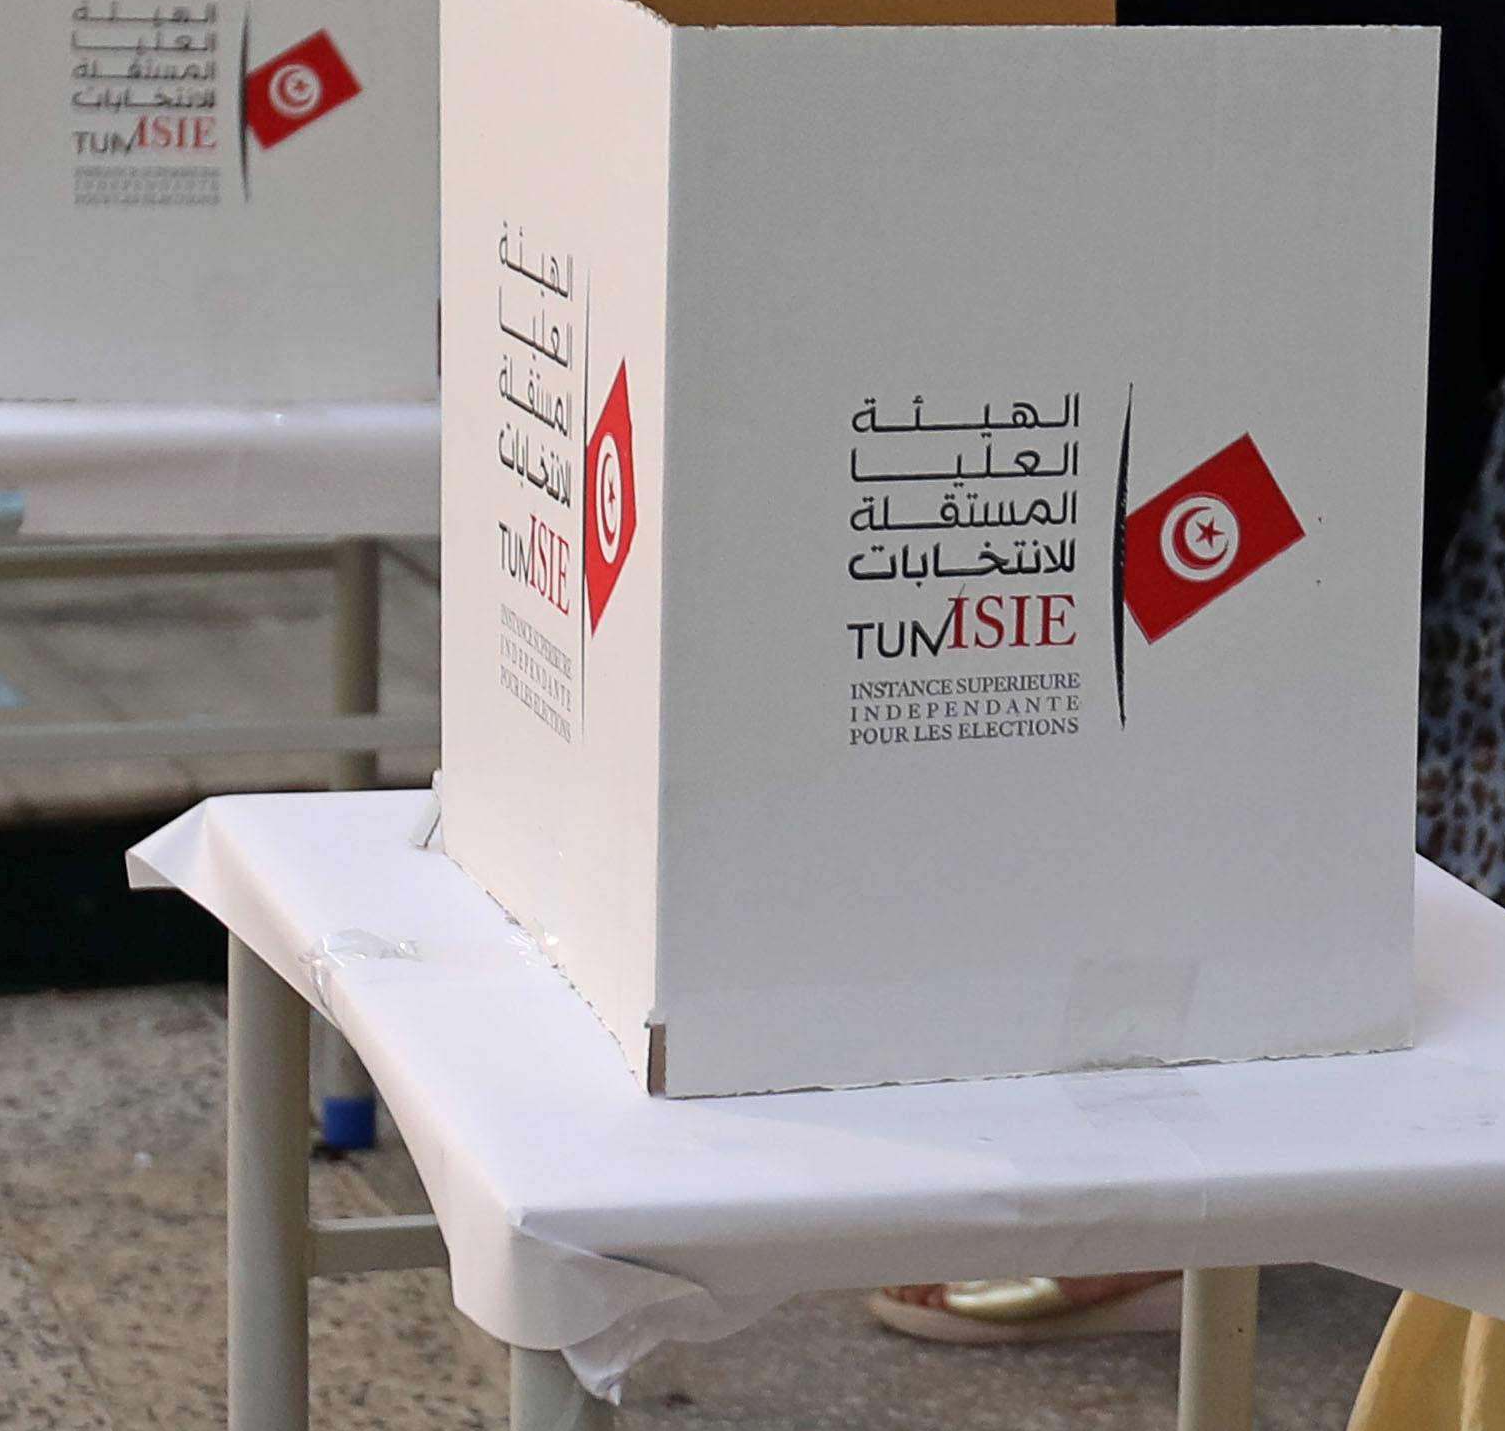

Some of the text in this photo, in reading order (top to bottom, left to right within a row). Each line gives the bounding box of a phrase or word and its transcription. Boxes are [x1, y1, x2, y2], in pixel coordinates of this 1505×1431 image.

[499, 220, 573, 302] الهيئة
[499, 286, 573, 371] العليا
[499, 354, 572, 440] المستقلة
[851, 392, 1080, 439] الهيئة
[850, 441, 1079, 488] العليا
[849, 490, 1078, 532] المستقلة
[847, 537, 1076, 588] للانتخابات
[846, 586, 1077, 660] TUNISIE
[850, 672, 1081, 701] INSTANCE SUPERIEURE
[850, 694, 1081, 723] INDEPENDANTE
[849, 717, 1080, 746] POUR LES ELECTIONS
